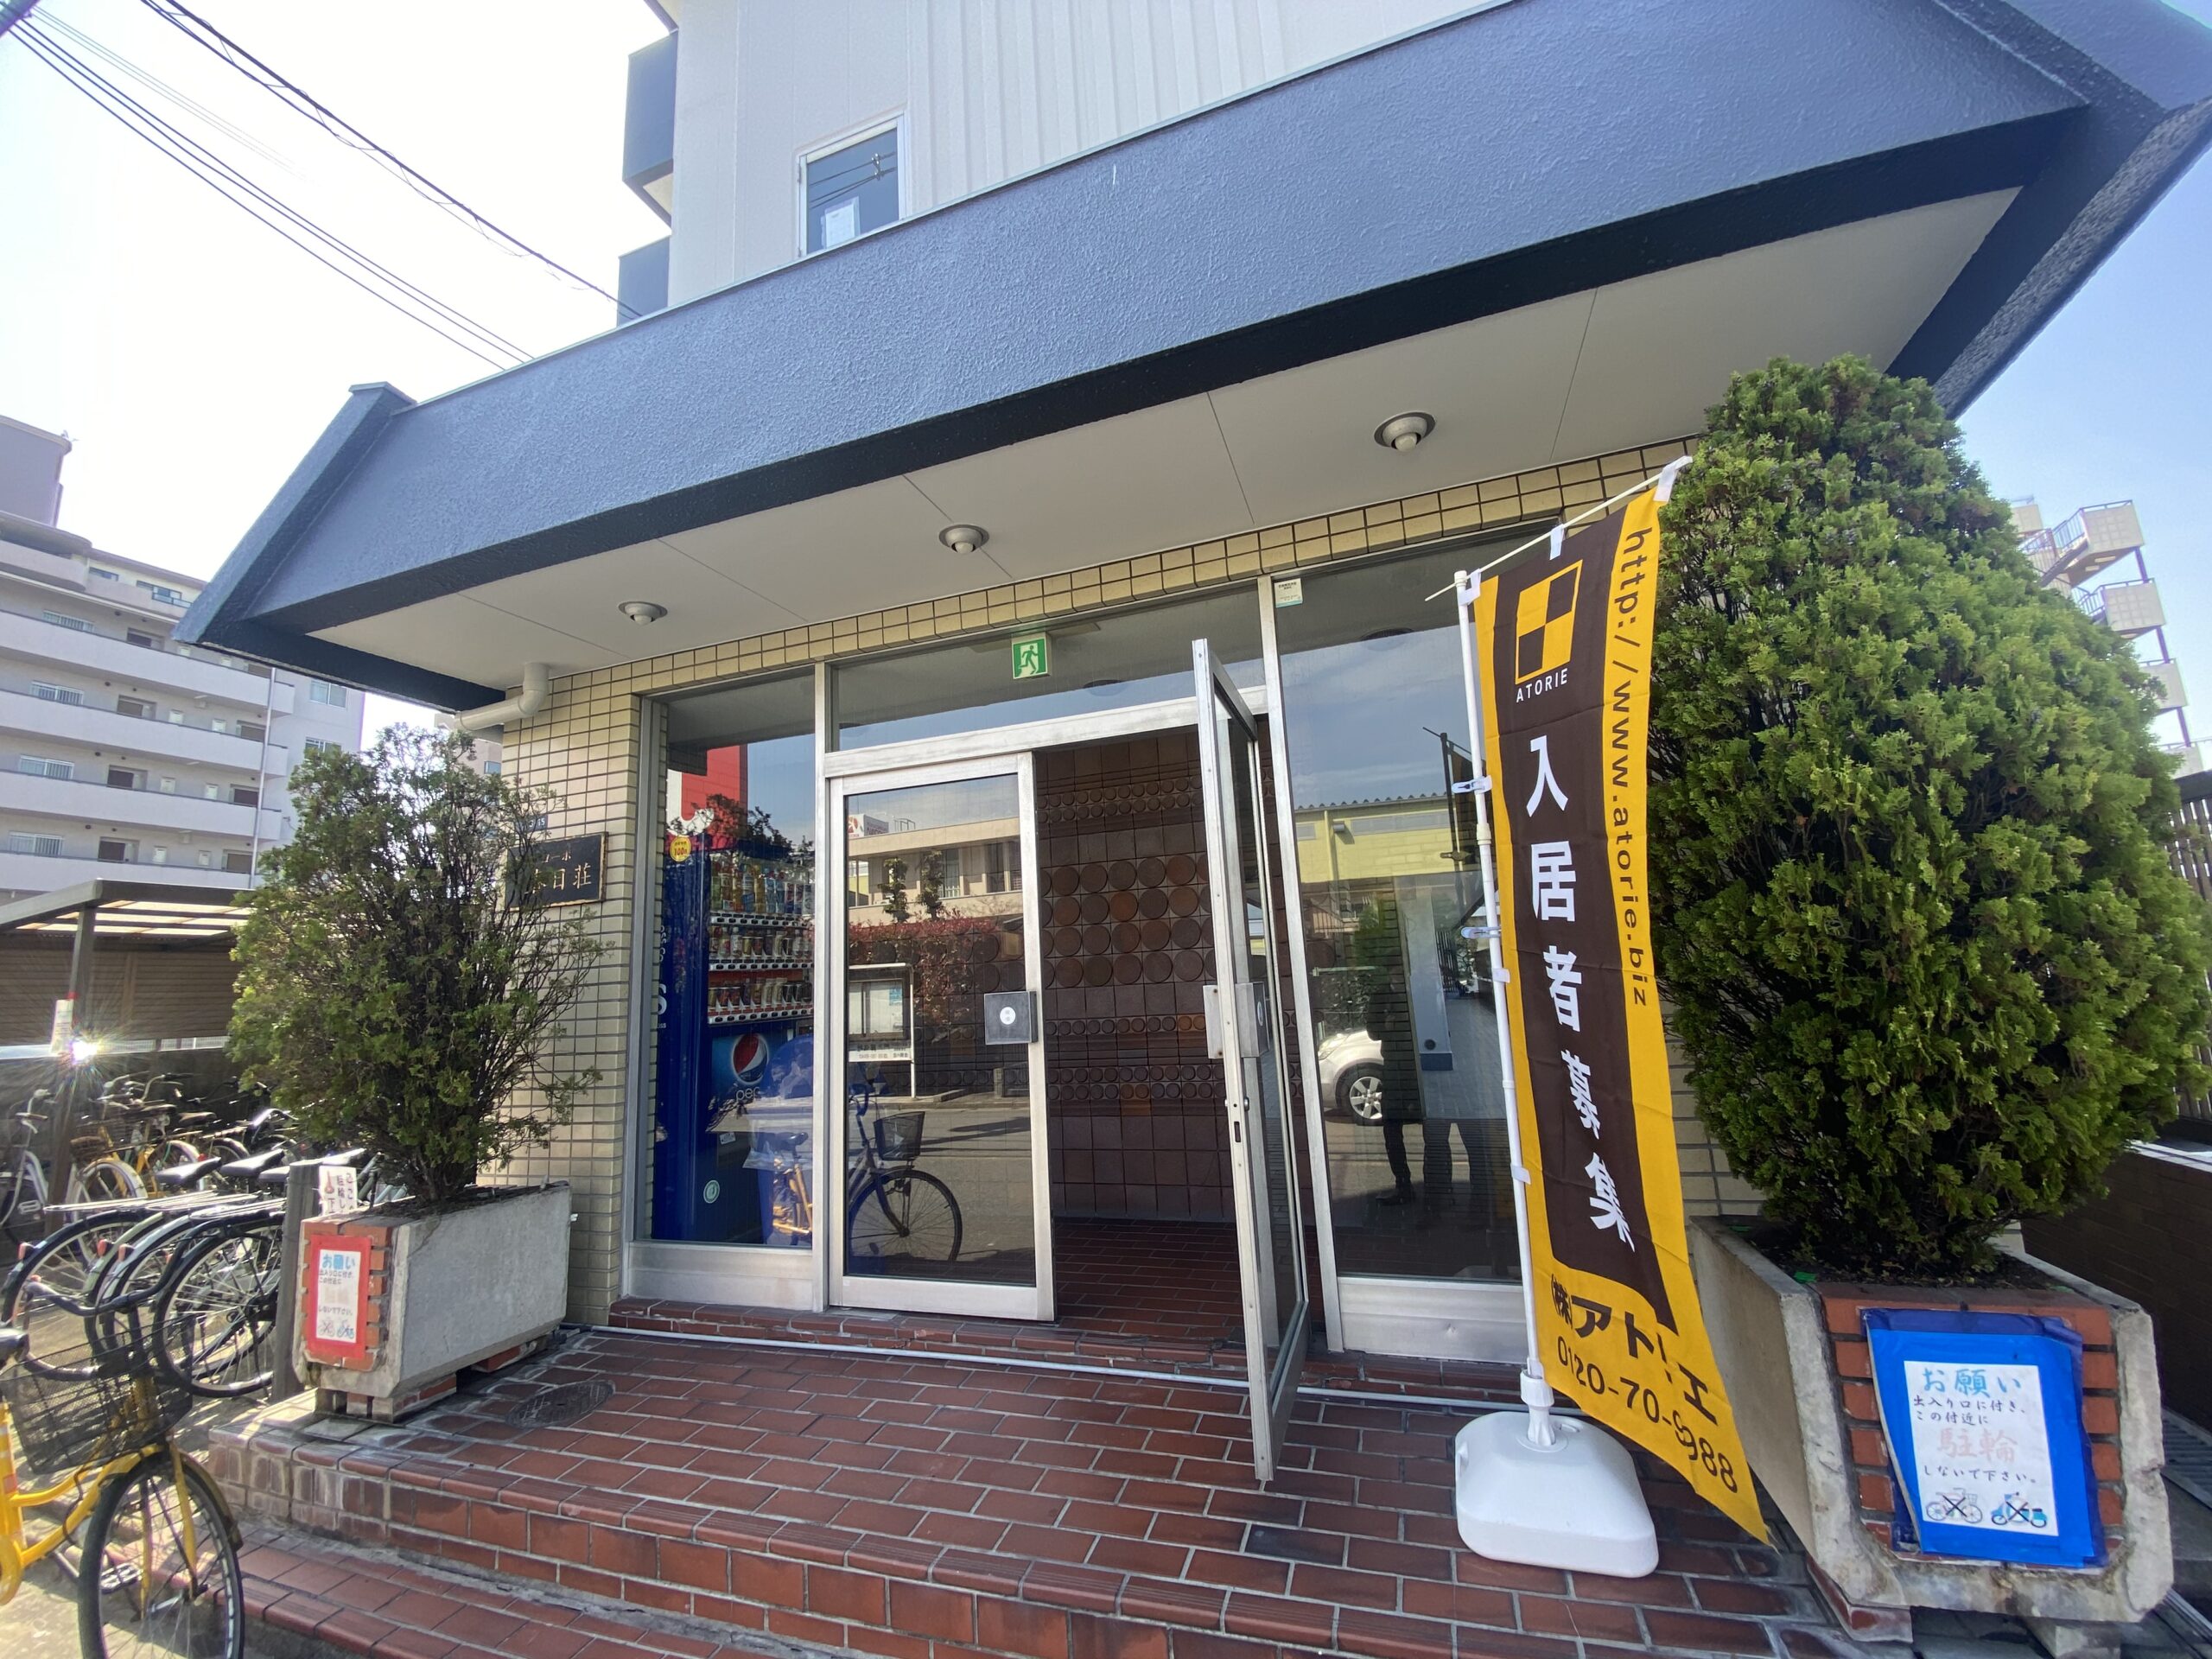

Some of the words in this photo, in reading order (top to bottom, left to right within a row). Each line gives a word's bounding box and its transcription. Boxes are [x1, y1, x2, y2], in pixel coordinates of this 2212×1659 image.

[1516, 668, 1568, 703] ATORIE
[1612, 527, 1652, 1007] http://www.atorie.biz
[1526, 735, 1635, 1252] 入居者募集
[1923, 1368, 2022, 1397] お願い
[1916, 1411, 1988, 1426] この付近に
[1937, 1427, 2018, 1464] 駐輪
